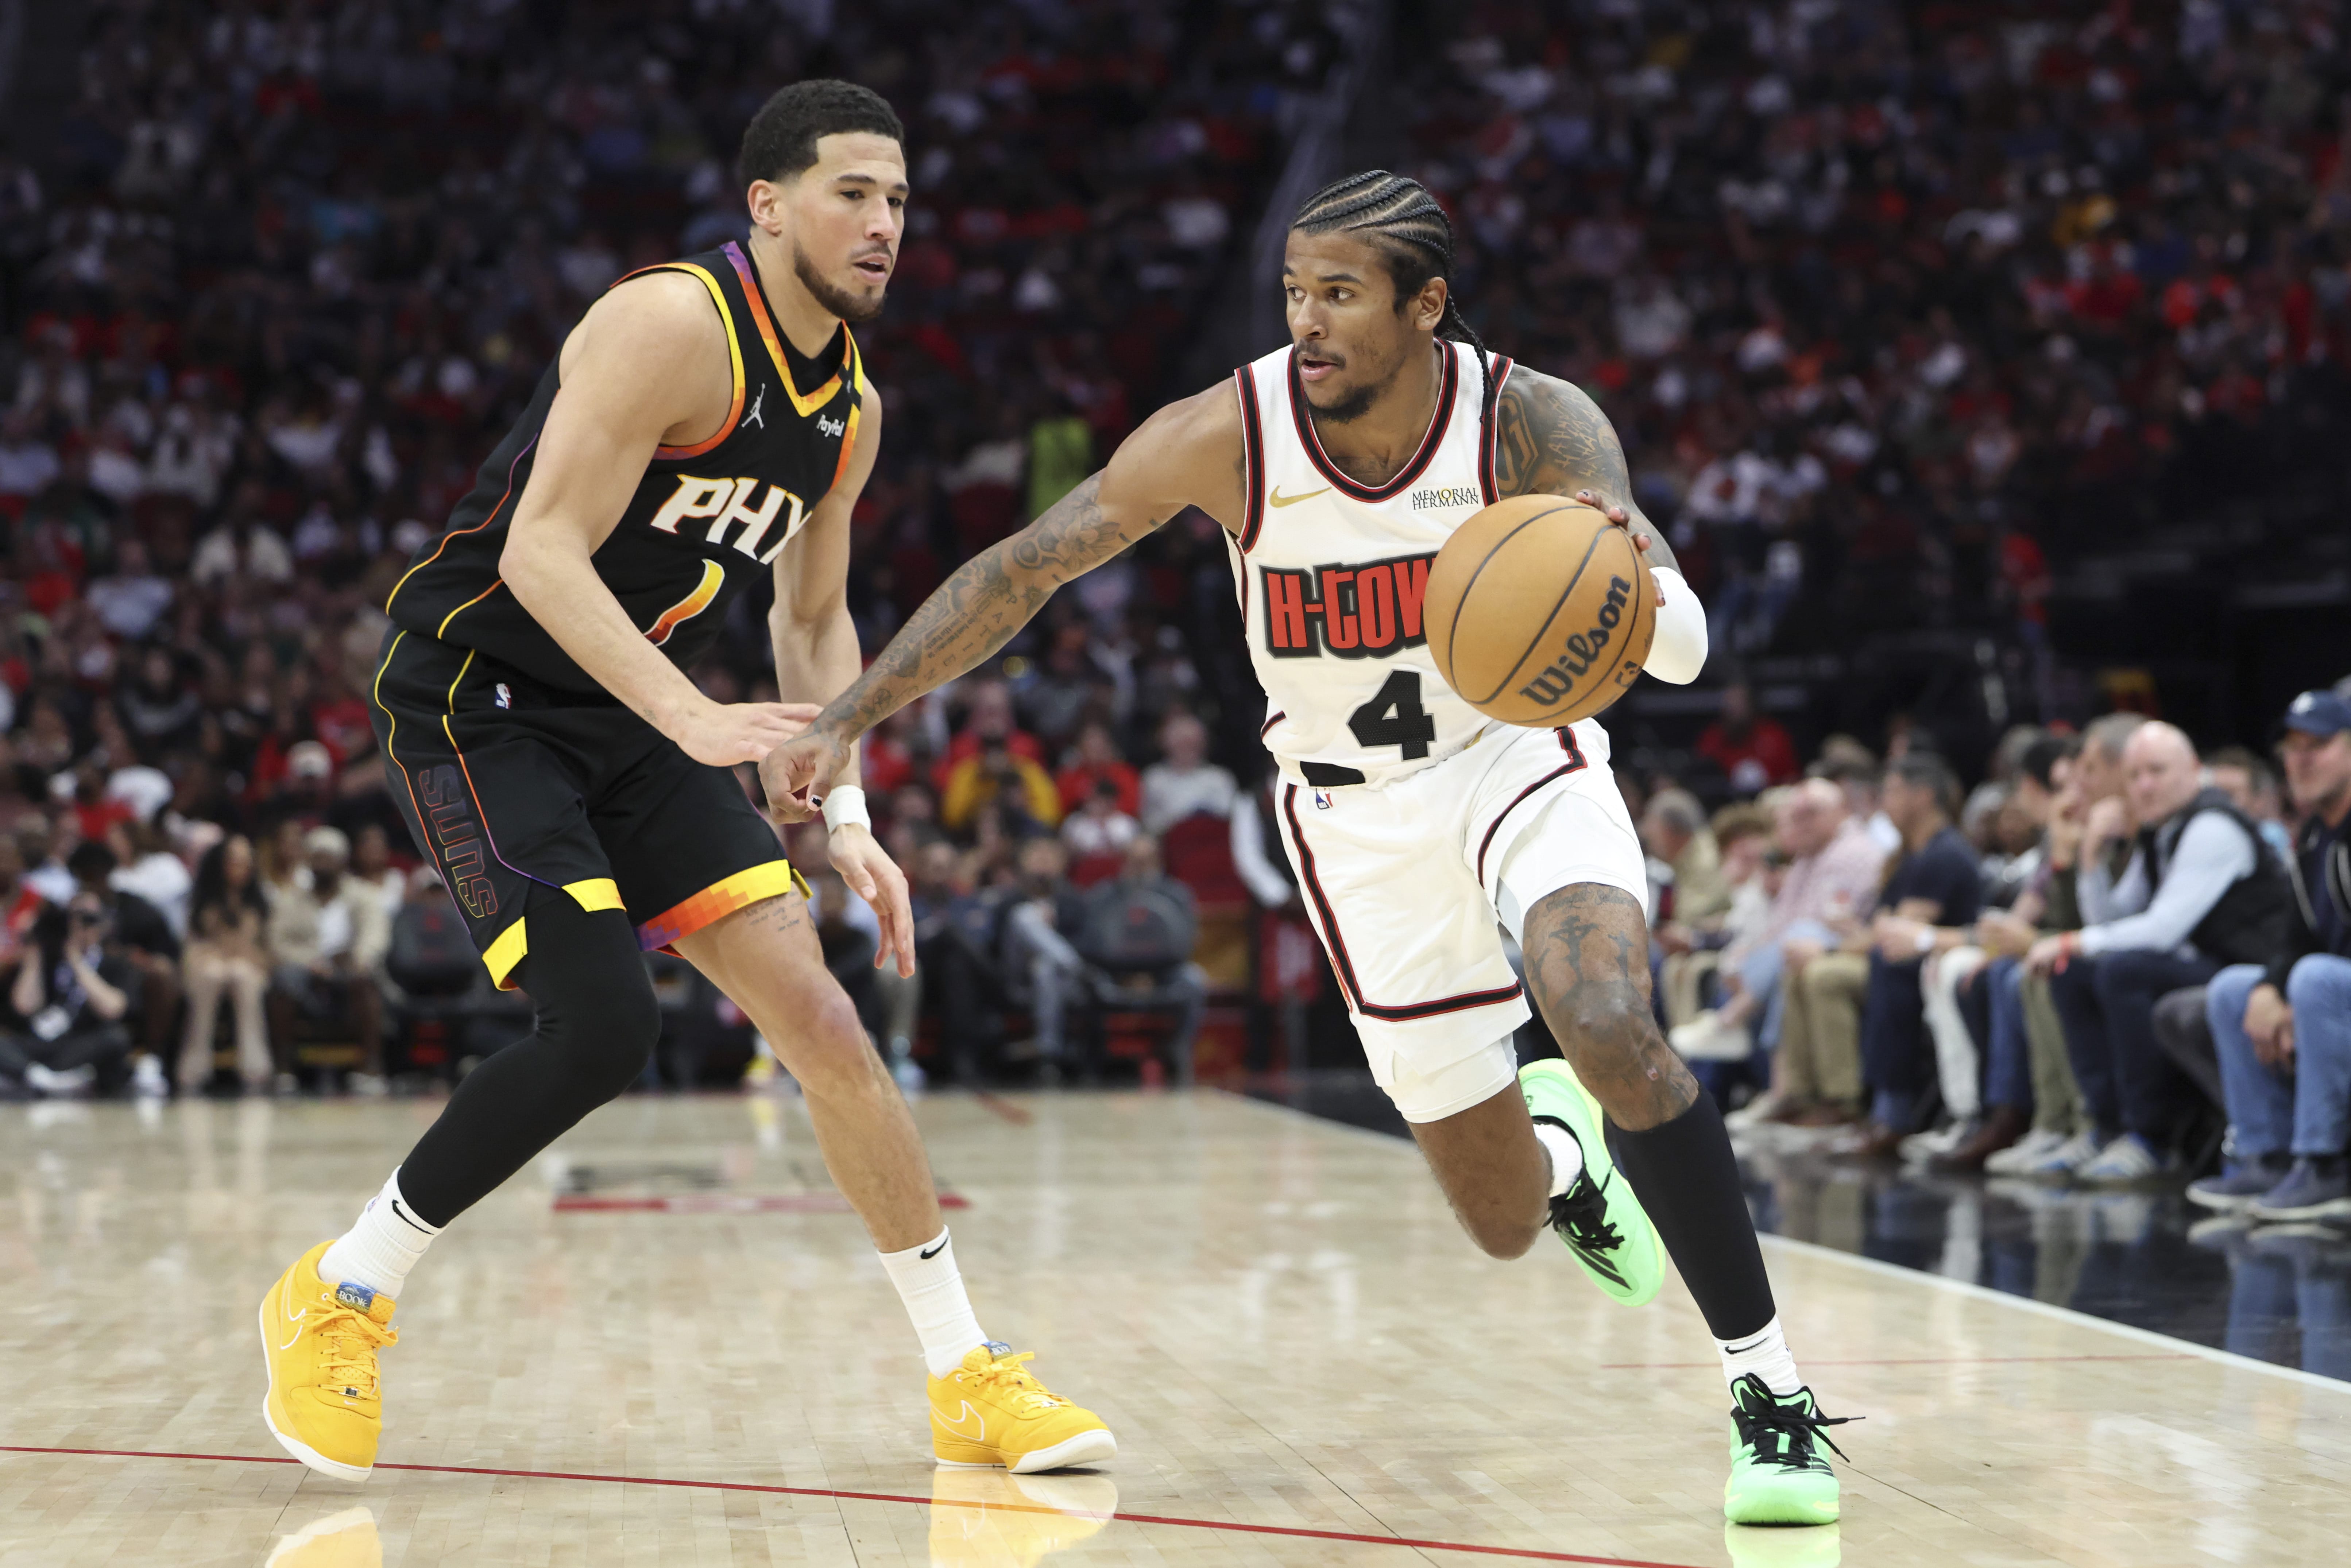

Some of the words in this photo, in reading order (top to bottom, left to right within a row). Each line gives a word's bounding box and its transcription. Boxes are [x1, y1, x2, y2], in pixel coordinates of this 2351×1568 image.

[816, 414, 844, 437] PayPal
[1412, 487, 1479, 502] MEMORIAL
[1413, 495, 1479, 510] HERMANN
[1517, 574, 1631, 706] Wilson
[1346, 668, 1437, 762] 4
[418, 764, 499, 918] SUNS
[338, 1290, 368, 1307] BOOK
